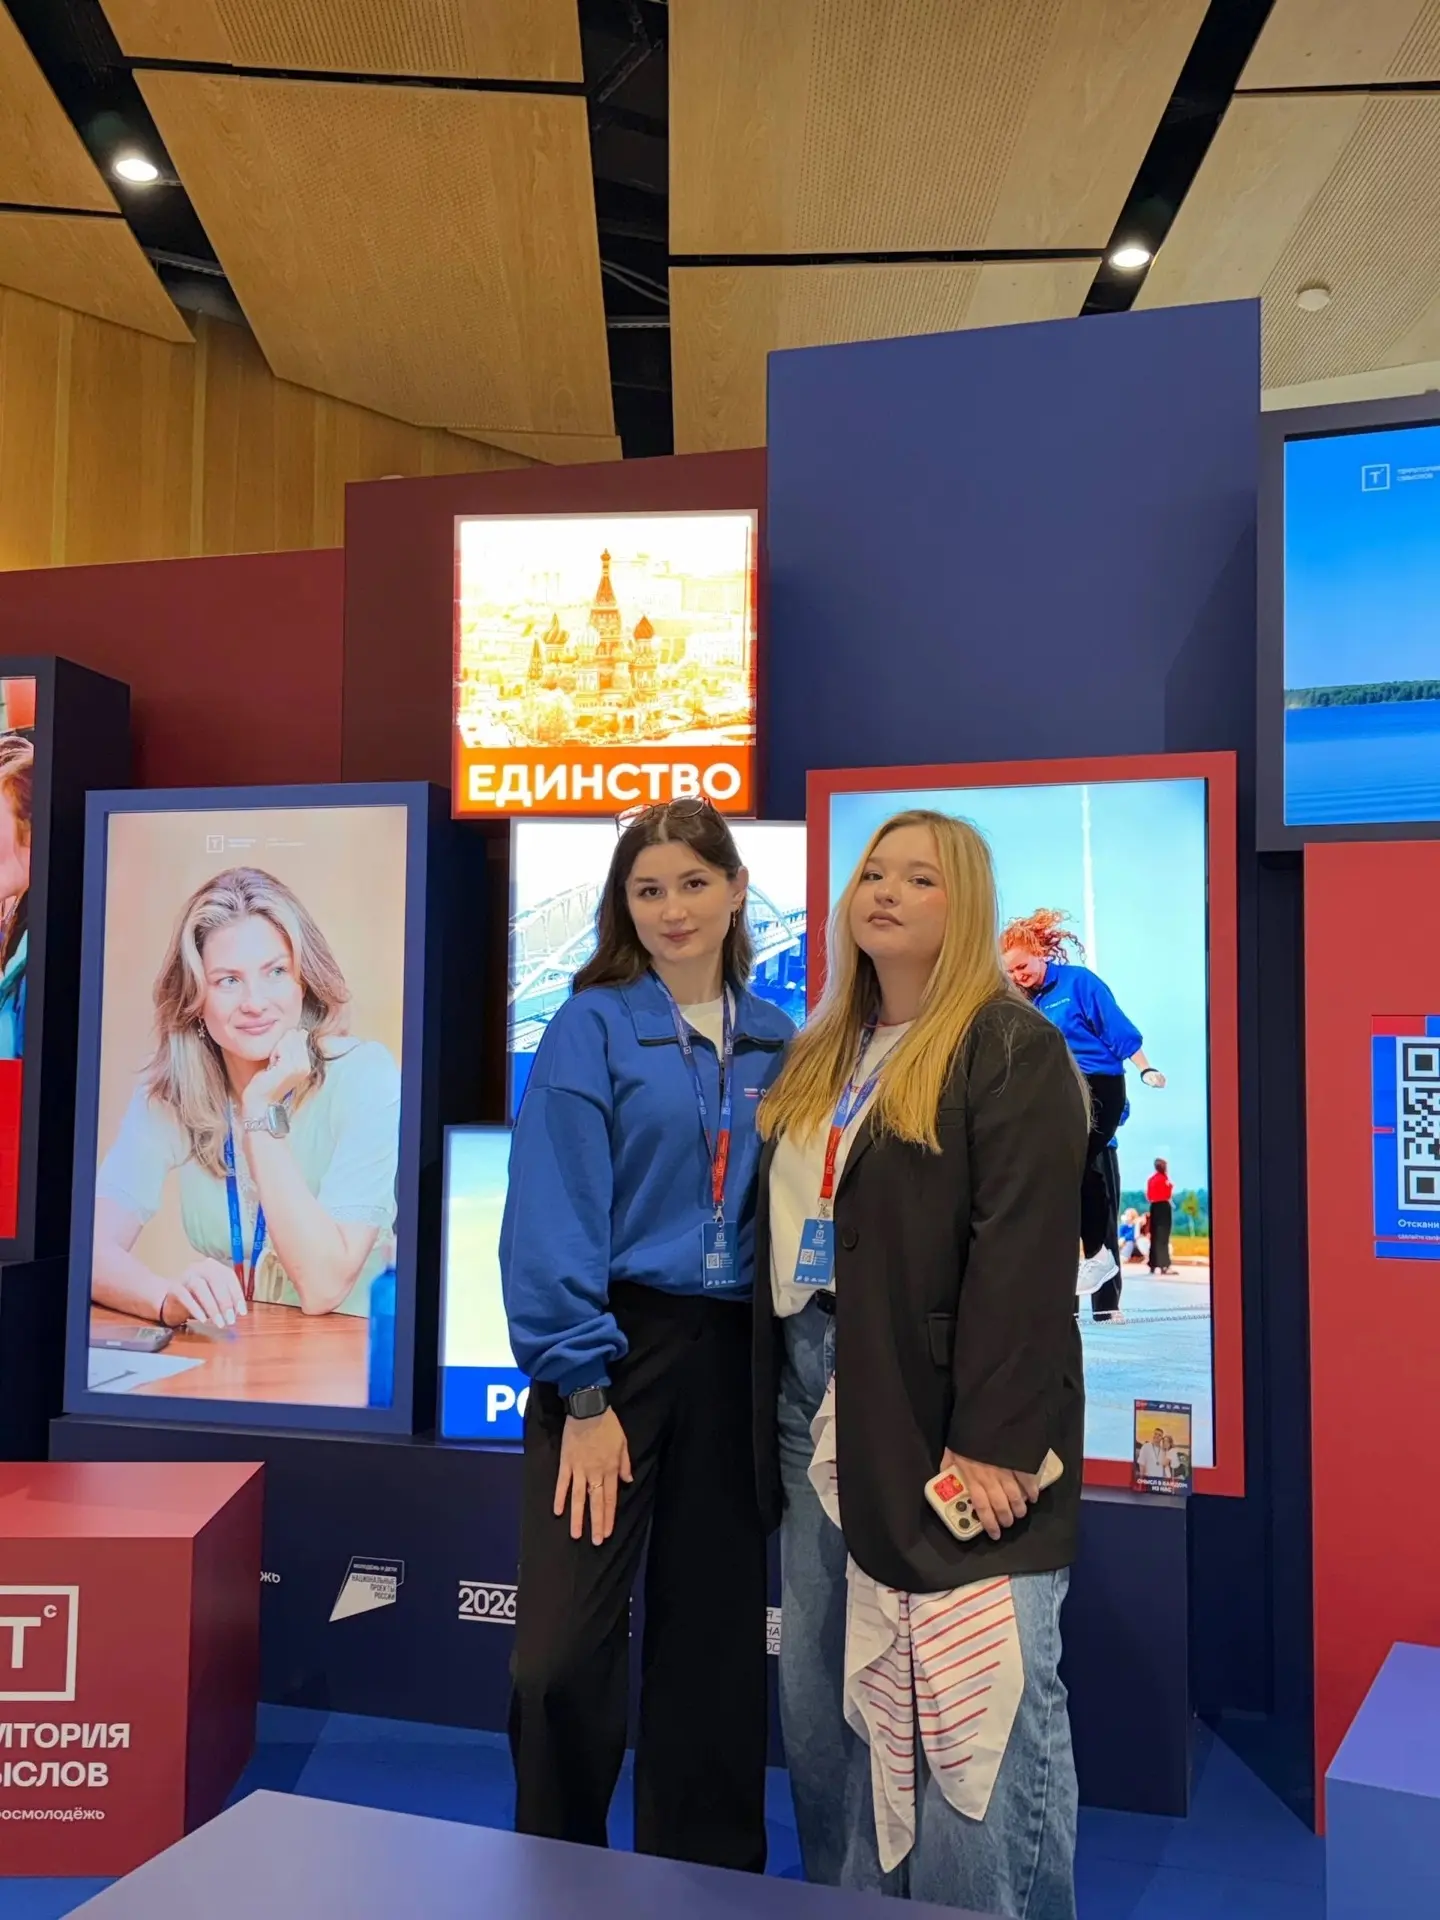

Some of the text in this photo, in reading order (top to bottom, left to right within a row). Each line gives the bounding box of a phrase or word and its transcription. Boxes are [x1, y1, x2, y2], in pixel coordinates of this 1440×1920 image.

[468, 763, 741, 807] ЕДИНСТВО
[458, 1587, 517, 1618] 2026
[0, 1807, 106, 1822] осмолодёжь
